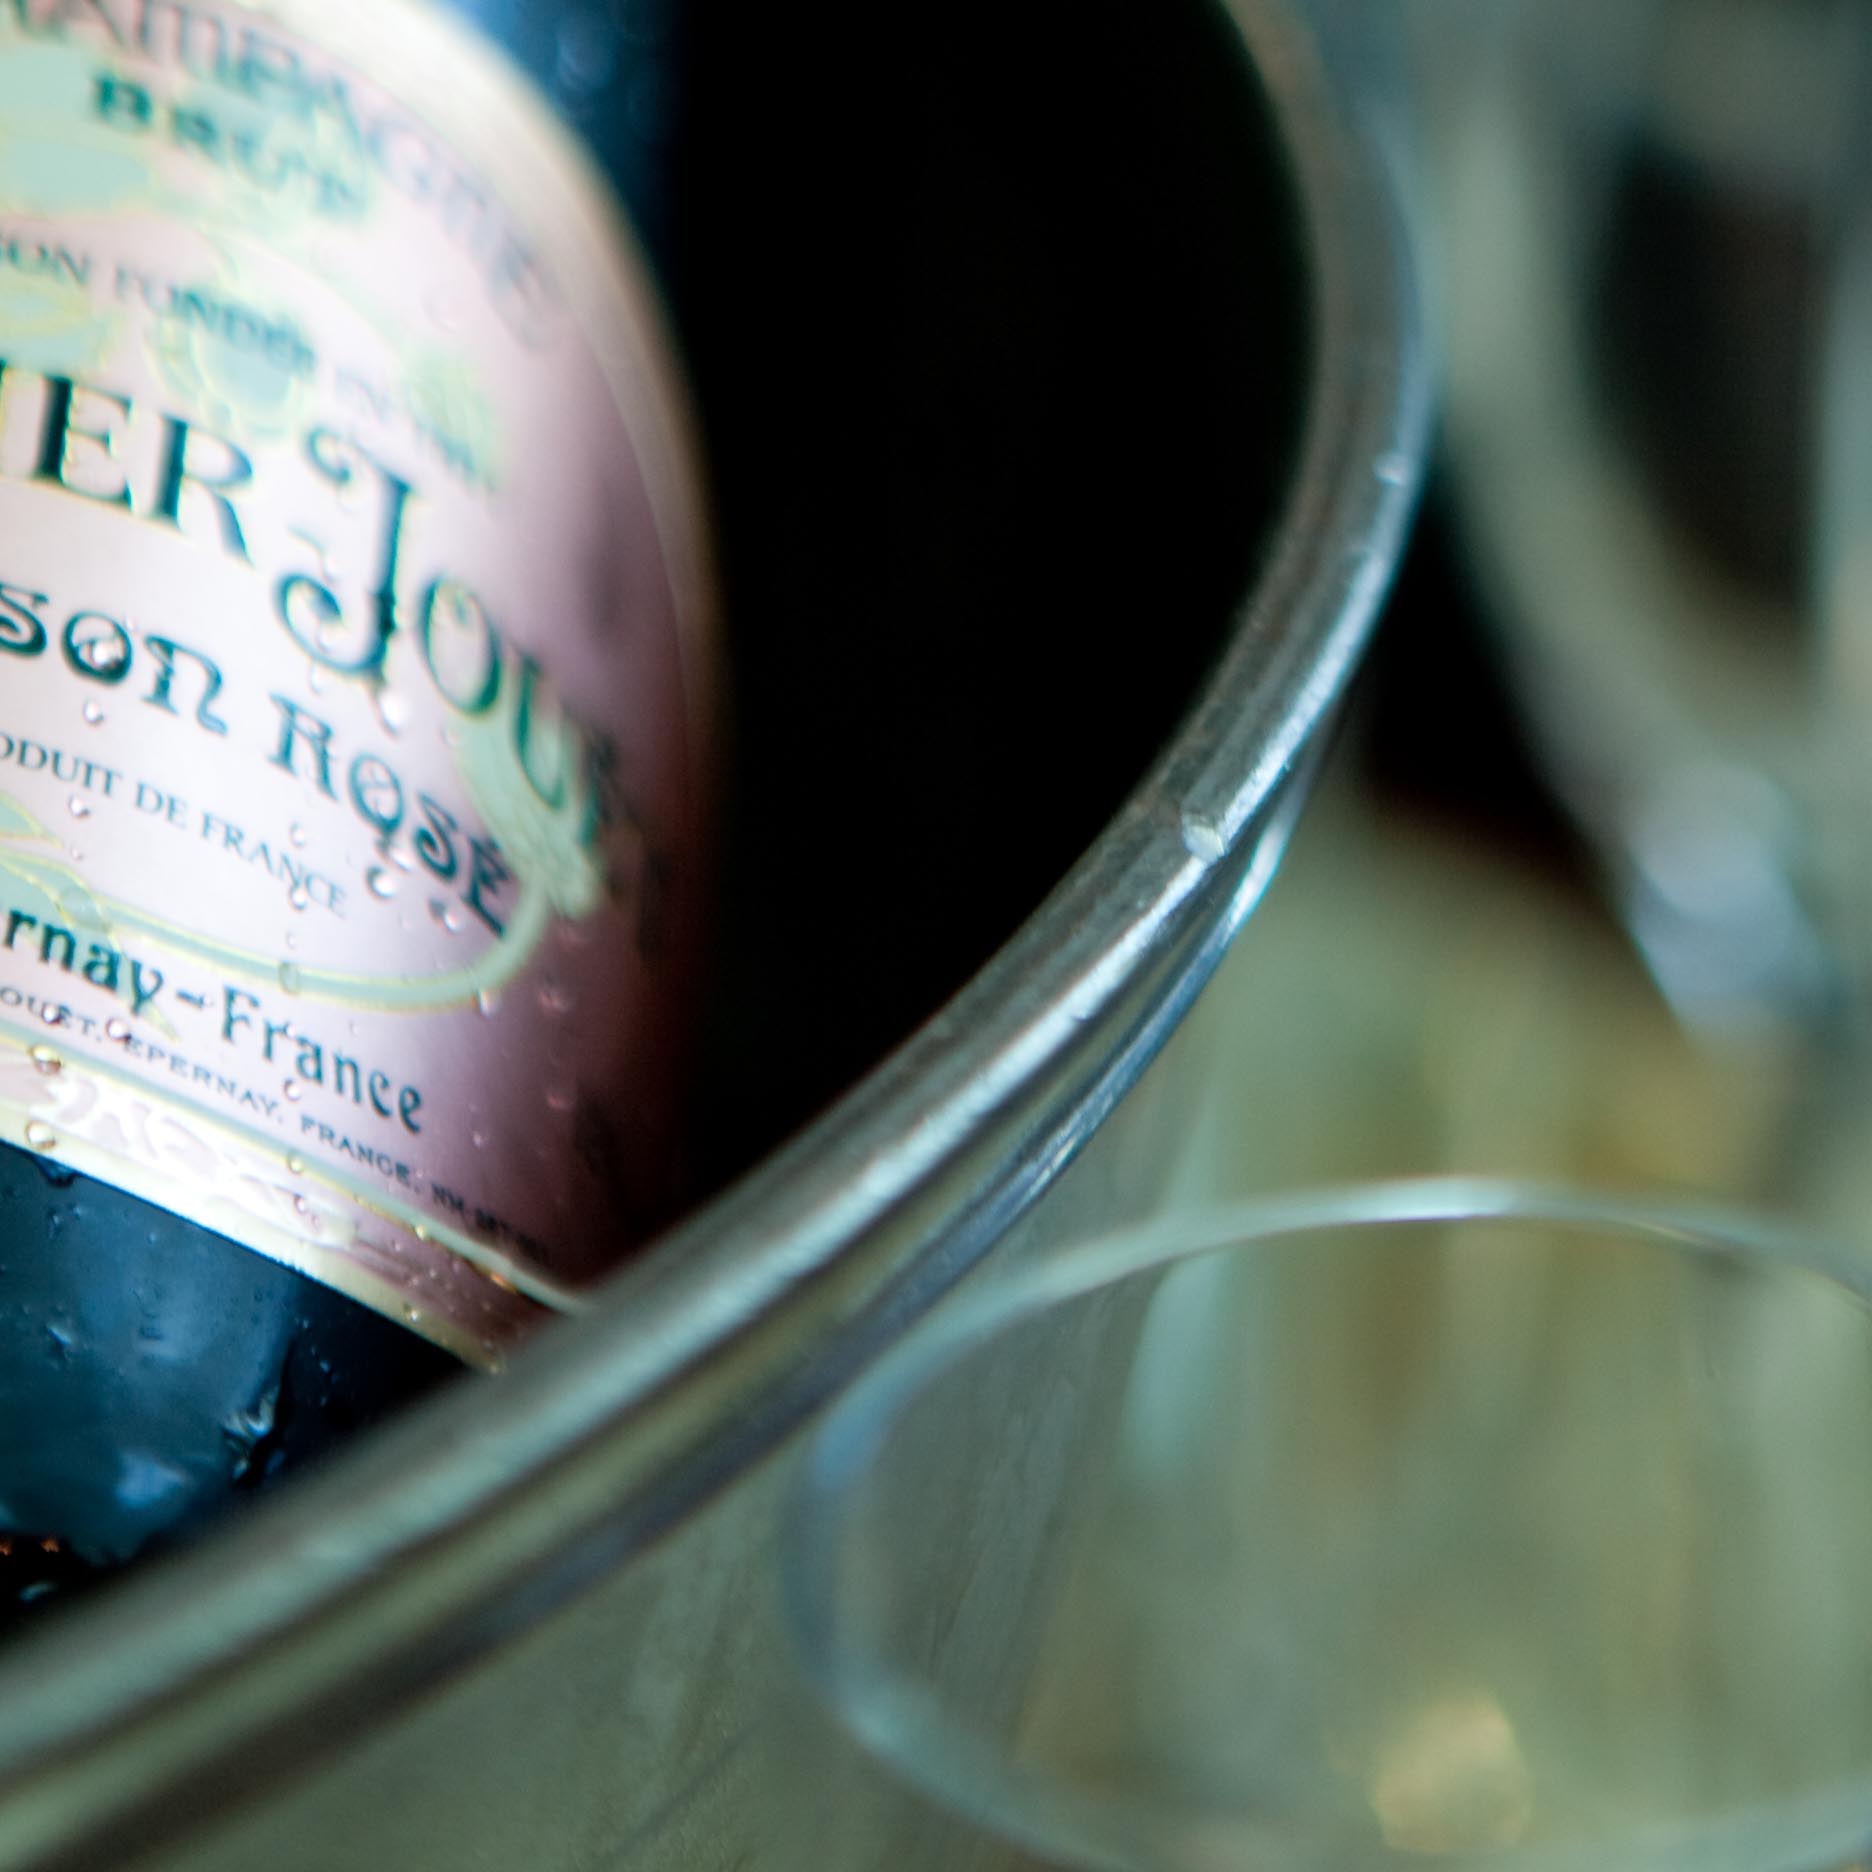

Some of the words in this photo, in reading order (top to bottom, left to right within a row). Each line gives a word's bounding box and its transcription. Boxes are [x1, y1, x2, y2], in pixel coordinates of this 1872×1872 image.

[92, 68, 370, 220] BRUT
[132, 781, 192, 828] DE
[200, 814, 350, 920] FRANCE
